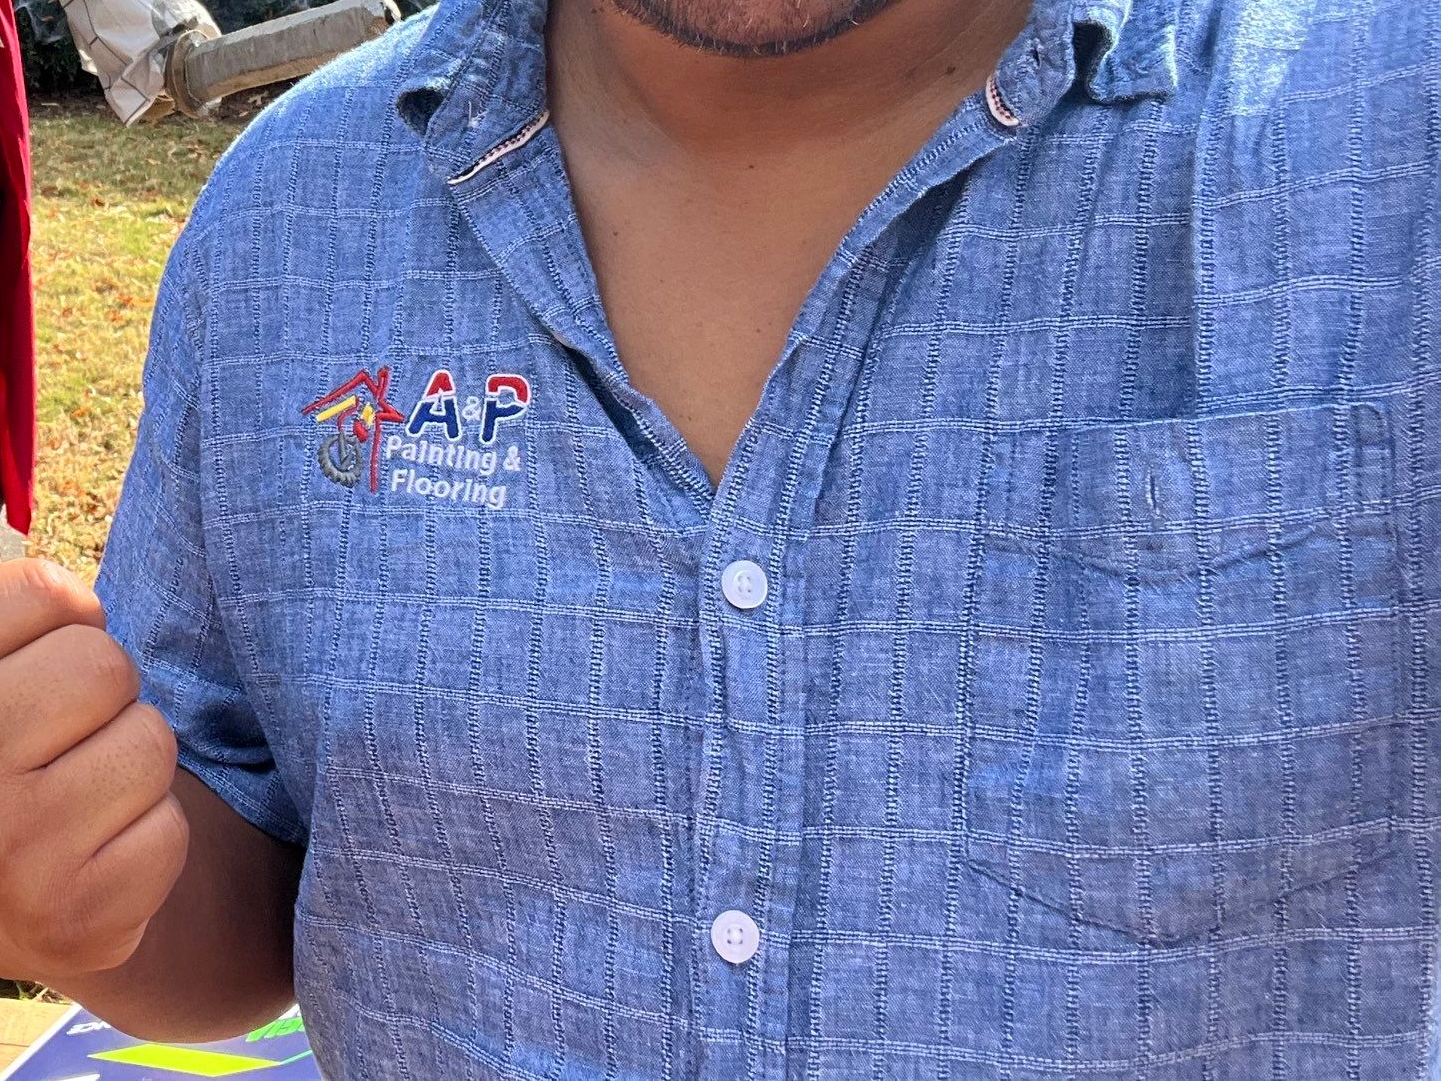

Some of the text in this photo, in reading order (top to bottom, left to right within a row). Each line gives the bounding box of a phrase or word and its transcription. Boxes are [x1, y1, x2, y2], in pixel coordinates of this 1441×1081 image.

[405, 368, 533, 445] A&P
[385, 434, 523, 477] Painting &
[390, 468, 509, 511] Flooring
